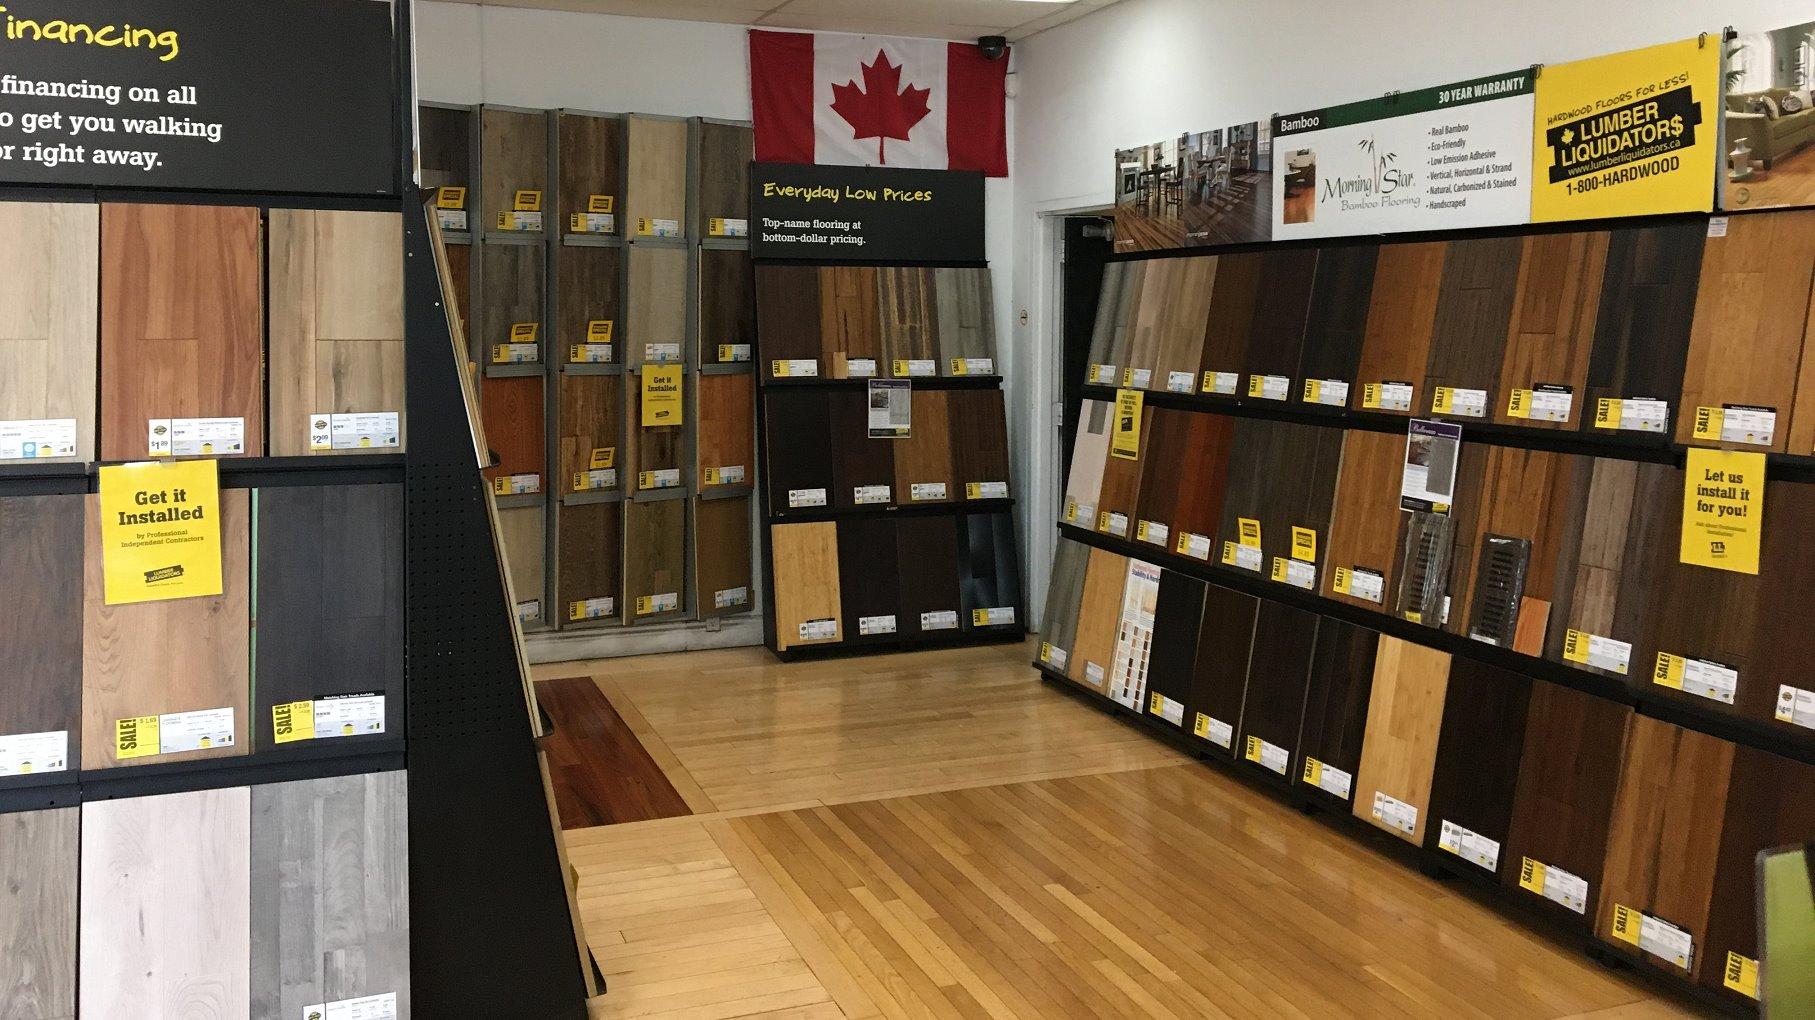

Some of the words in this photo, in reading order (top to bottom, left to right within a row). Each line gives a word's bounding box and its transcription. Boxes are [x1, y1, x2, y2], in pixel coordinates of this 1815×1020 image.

[0, 7, 180, 62] inancing
[1, 75, 121, 105] financing
[128, 86, 160, 103] on
[167, 86, 197, 105] all
[1438, 90, 1450, 104] 30
[1451, 86, 1473, 101] YEAR
[1473, 76, 1525, 98] WARRANTY
[1547, 104, 1592, 126] HARDWOOD
[1595, 91, 1633, 111] FLOORS
[1635, 85, 1655, 98] FOR
[1658, 71, 1690, 91] LESS!
[21, 111, 62, 135] get
[69, 116, 115, 136] you
[121, 117, 223, 142] walking
[1281, 115, 1320, 132] Bamboo
[1431, 126, 1444, 137] Real
[1445, 123, 1470, 135] Bamboo
[1580, 101, 1659, 141] LUMBER
[1431, 138, 1466, 152] Eco-Friendly
[22, 142, 85, 167] right
[92, 149, 163, 171] away.
[1430, 156, 1442, 166] Low
[1443, 153, 1469, 165] Emission
[1470, 149, 1497, 161] Adhesive
[1567, 139, 1681, 176] www.lumberliquidators.ca
[1429, 169, 1453, 181] Vertical,
[1454, 166, 1484, 178] Horizontal
[1485, 166, 1491, 175] &
[1491, 162, 1513, 174] Strand
[1566, 155, 1680, 195] 1-800-HARDWOOD
[763, 182, 840, 204] Everyday
[845, 185, 877, 201] Low
[883, 187, 932, 202] Prices
[1321, 177, 1373, 203] Morning
[1429, 183, 1452, 195] Natural,
[1453, 180, 1486, 193] Carbonized
[1487, 180, 1492, 189] &
[1492, 177, 1517, 188] Stained
[1341, 200, 1379, 212] Bamboo
[1381, 196, 1421, 210] Flooring
[1429, 198, 1467, 211] Handscraped
[762, 217, 811, 230] Top-name
[812, 218, 851, 232] flooring
[852, 221, 862, 230] at
[762, 233, 828, 244] bottom-dollar
[830, 235, 867, 245] pricing.
[1705, 469, 1724, 482] Let
[1728, 474, 1744, 484] us
[134, 491, 168, 506] Get
[173, 488, 186, 502] it
[1697, 484, 1736, 500] install
[1740, 488, 1750, 500] it
[118, 506, 204, 526] Installed
[1697, 500, 1714, 513] for
[1718, 505, 1748, 518] you!
[121, 540, 164, 548] Independent
[166, 536, 204, 545] Contractors
[146, 529, 188, 538] Professional
[1657, 654, 1670, 679] SALE!
[275, 705, 292, 735] SALE!
